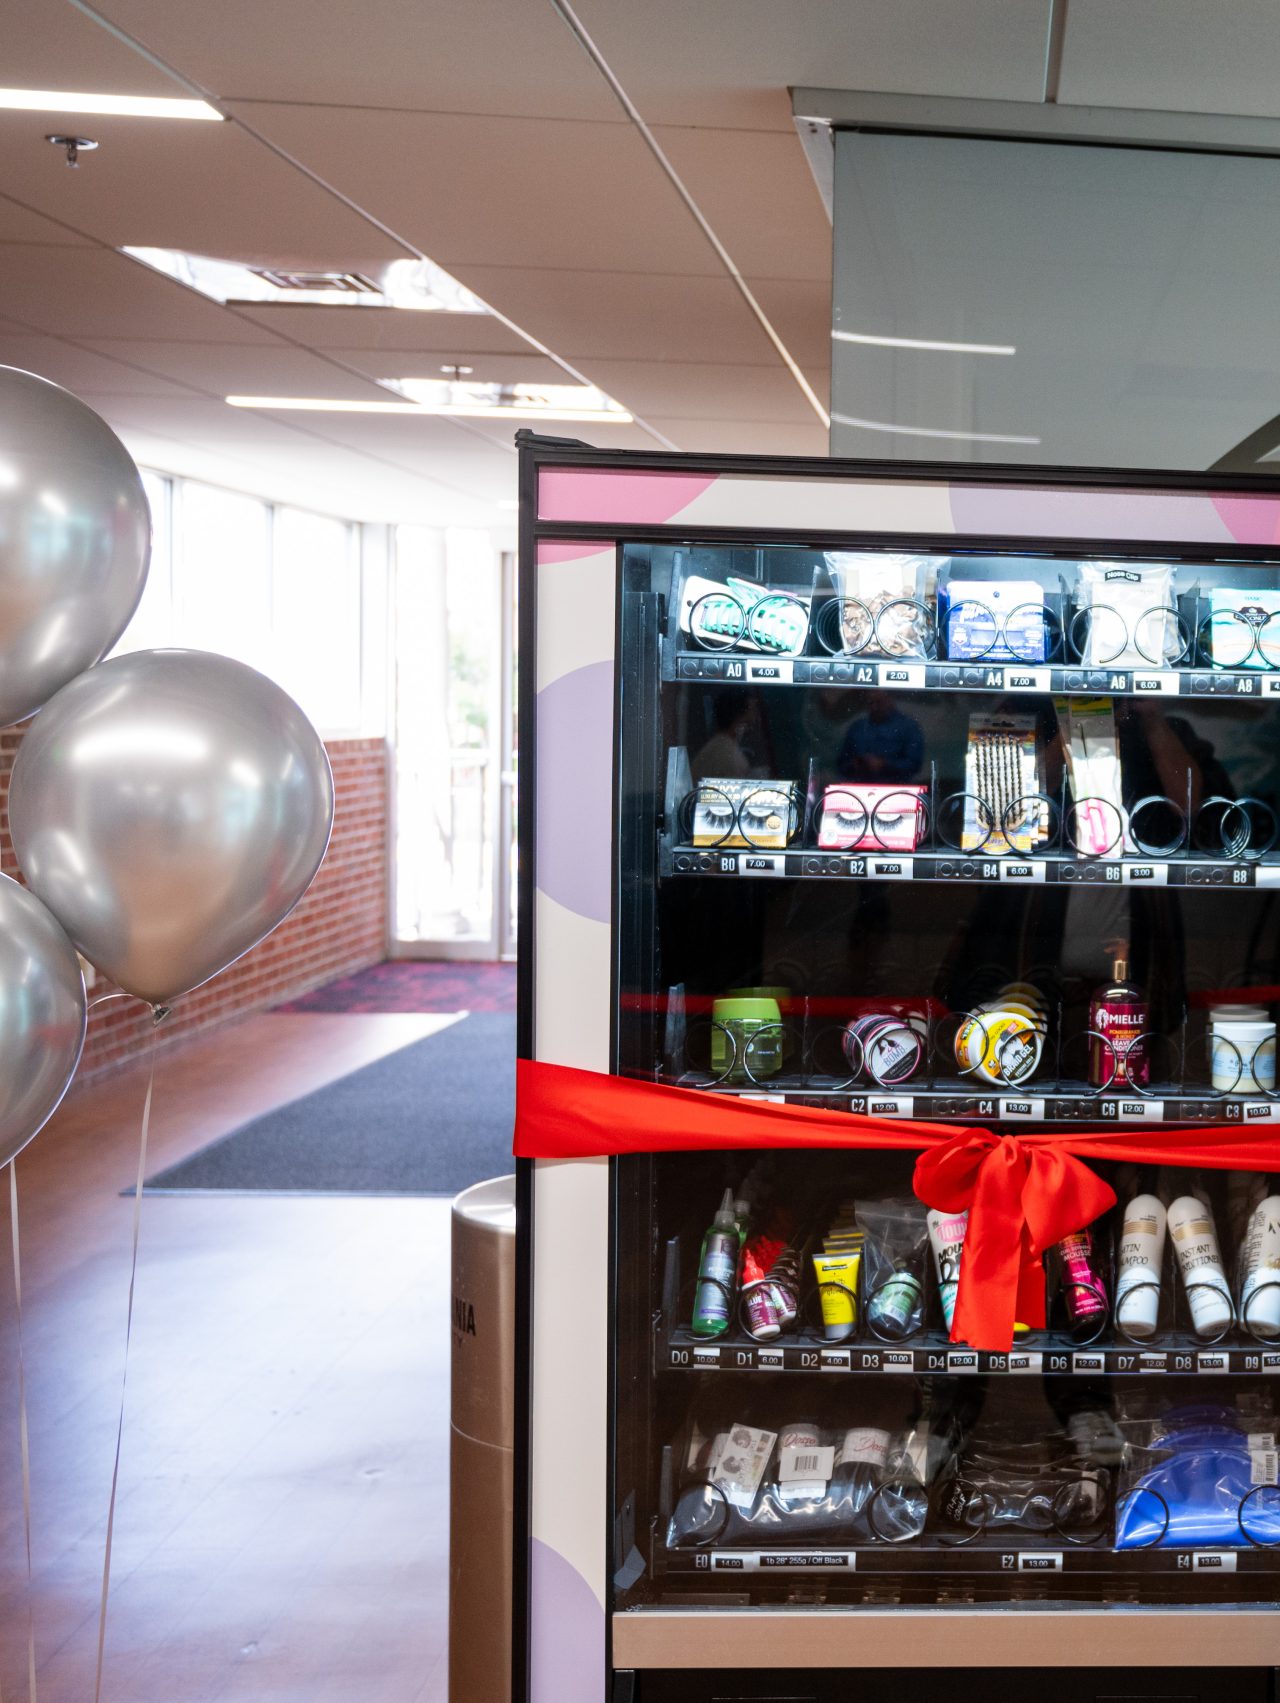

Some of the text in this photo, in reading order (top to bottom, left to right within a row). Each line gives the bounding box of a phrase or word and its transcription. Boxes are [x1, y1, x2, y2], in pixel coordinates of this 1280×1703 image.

[726, 663, 742, 677] A0
[758, 668, 775, 676] 4.00
[857, 668, 873, 682] A2
[890, 672, 907, 680] 2.00
[986, 674, 1002, 687] A4
[1013, 678, 1030, 686] 7.00
[1110, 676, 1126, 689] A6
[1237, 679, 1253, 692] A8
[721, 858, 735, 871] B0
[749, 860, 765, 868] 7.00
[850, 861, 865, 874] B2
[882, 864, 899, 872] 7.00
[983, 864, 998, 877] B4
[1106, 867, 1120, 880] B6
[1233, 870, 1247, 883] B8
[1109, 1014, 1144, 1025] MIELLE
[1020, 1044, 1034, 1058] GEL
[851, 1099, 865, 1112] C2
[875, 1103, 895, 1112] 12.00
[979, 1101, 992, 1113] C4
[1008, 1104, 1028, 1113] 13.00
[1102, 1103, 1115, 1116] C6
[1124, 1105, 1143, 1113] 12.00
[1226, 1105, 1240, 1118] C8
[1250, 1107, 1269, 1115] 10.00
[938, 1242, 963, 1263] MOU
[1063, 1250, 1091, 1262] MOUSSE
[672, 1351, 688, 1364] D0
[696, 1356, 716, 1364] 10.00
[737, 1352, 752, 1365] D1
[762, 1356, 778, 1364] 6.00
[801, 1353, 818, 1366] D2
[827, 1357, 843, 1365] 4.00
[862, 1354, 879, 1368] D3
[889, 1355, 908, 1363] 10.00
[928, 1356, 945, 1369] D4
[953, 1356, 972, 1364] 12.00
[989, 1356, 1006, 1369] D5
[1050, 1356, 1067, 1369] D6
[1078, 1359, 1098, 1367] 12.00
[1118, 1356, 1134, 1369] D7
[1175, 1356, 1192, 1369] D8
[1203, 1359, 1222, 1367] 13.00
[1245, 1356, 1259, 1369] D9
[695, 1554, 708, 1568] E0
[789, 1557, 807, 1566] 255g
[812, 1557, 823, 1565] Off
[824, 1557, 844, 1565] Black
[1002, 1555, 1014, 1569] E2
[1028, 1559, 1049, 1567] 13.00
[1177, 1555, 1190, 1569] E4
[1201, 1557, 1220, 1565] 13.00
